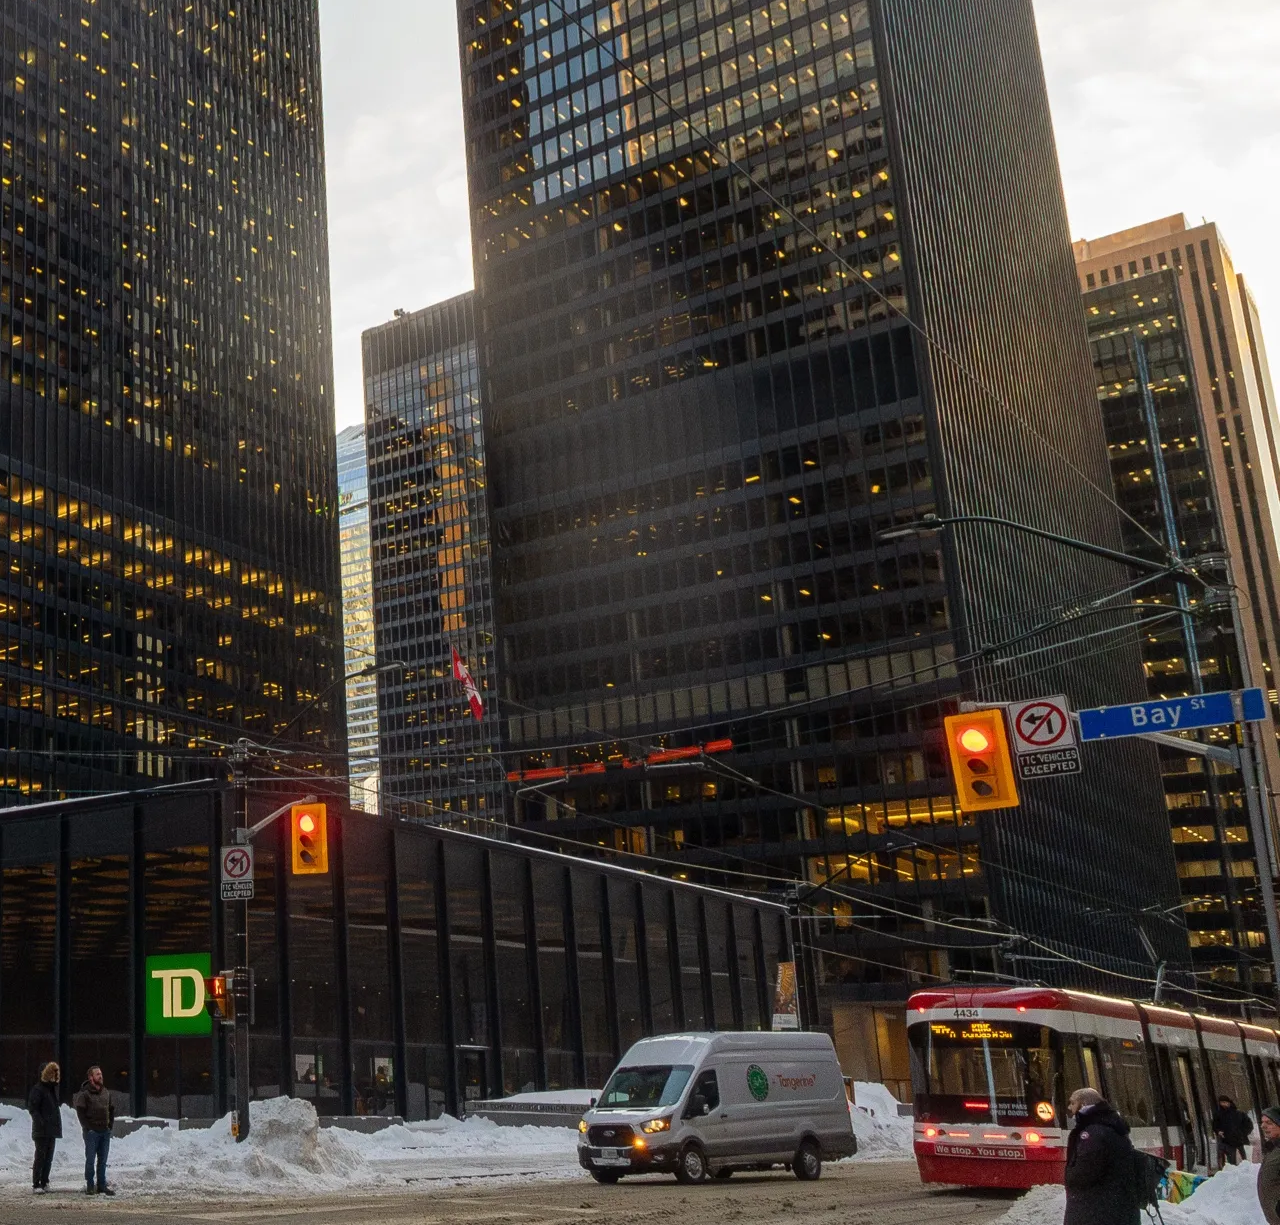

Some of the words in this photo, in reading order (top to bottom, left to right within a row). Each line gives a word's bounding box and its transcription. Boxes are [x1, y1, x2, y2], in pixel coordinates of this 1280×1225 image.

[1130, 704, 1183, 728] Bay
[1190, 698, 1206, 711] St
[1019, 754, 1037, 766] TTC
[1039, 750, 1077, 764] VEHICLES
[1023, 761, 1076, 776] EXCEPTED
[222, 883, 232, 891] TTC
[232, 882, 252, 890] VEHICLES
[223, 889, 252, 898] EXCEPTED
[151, 968, 205, 1018] TD
[953, 1009, 979, 1018] 4434
[936, 1144, 949, 1153] We
[951, 1146, 974, 1156] stop.
[976, 1147, 996, 1156] You
[998, 1148, 1024, 1159] stop.
